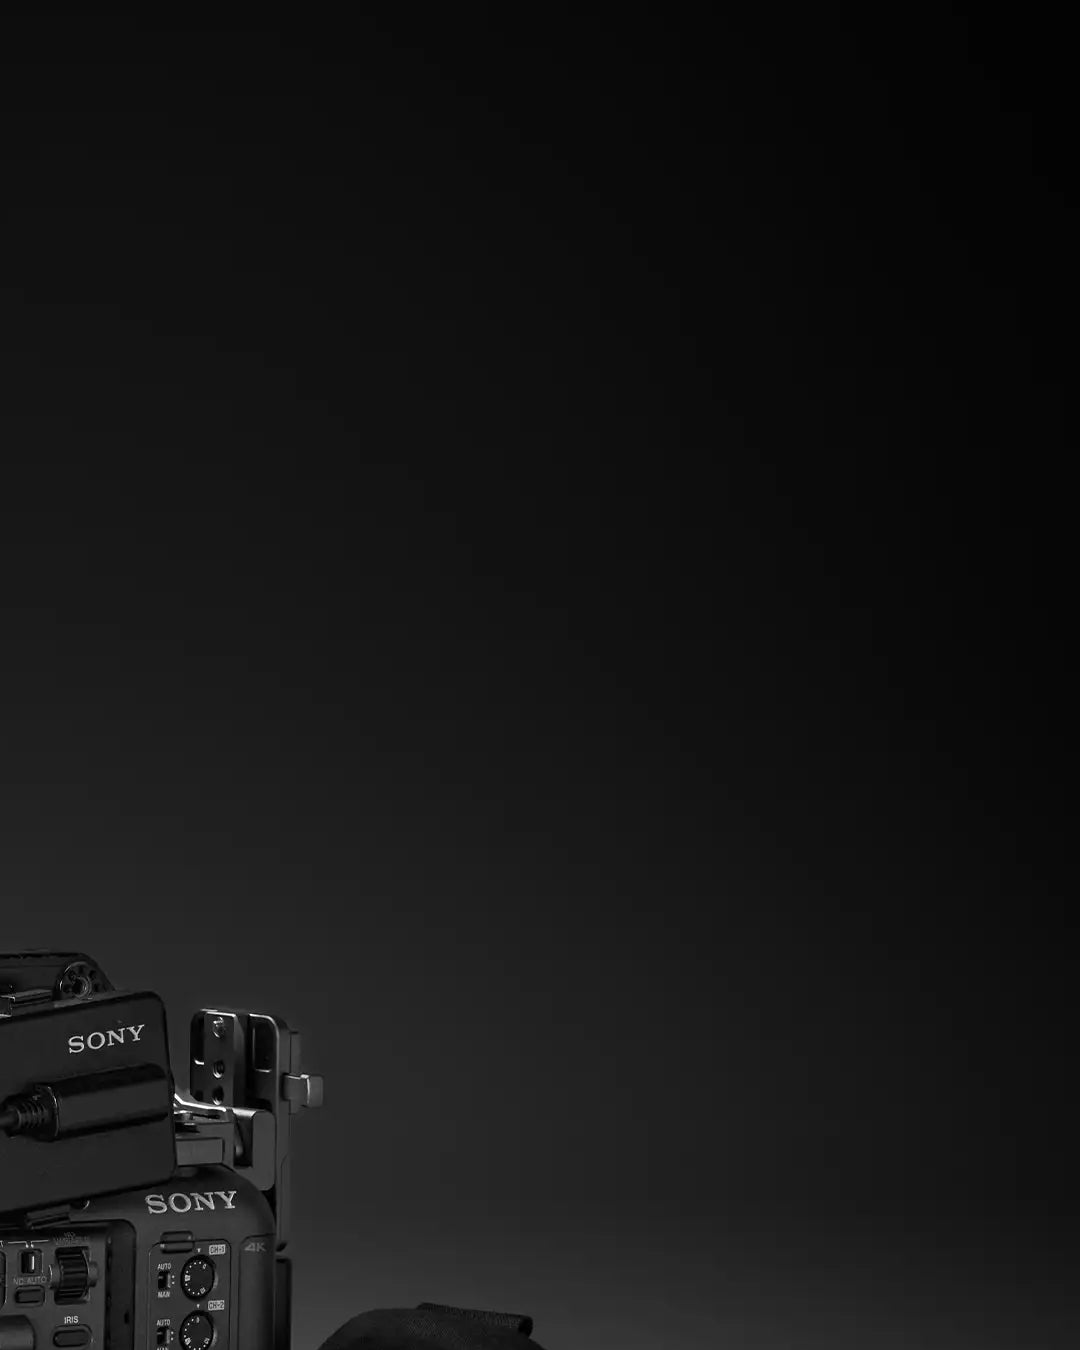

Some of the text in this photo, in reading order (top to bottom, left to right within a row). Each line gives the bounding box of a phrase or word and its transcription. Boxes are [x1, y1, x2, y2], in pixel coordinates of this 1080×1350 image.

[67, 1023, 145, 1054] SONY
[145, 1190, 237, 1214] SONY
[244, 1243, 266, 1252] 4K
[64, 1316, 79, 1324] IRIS
